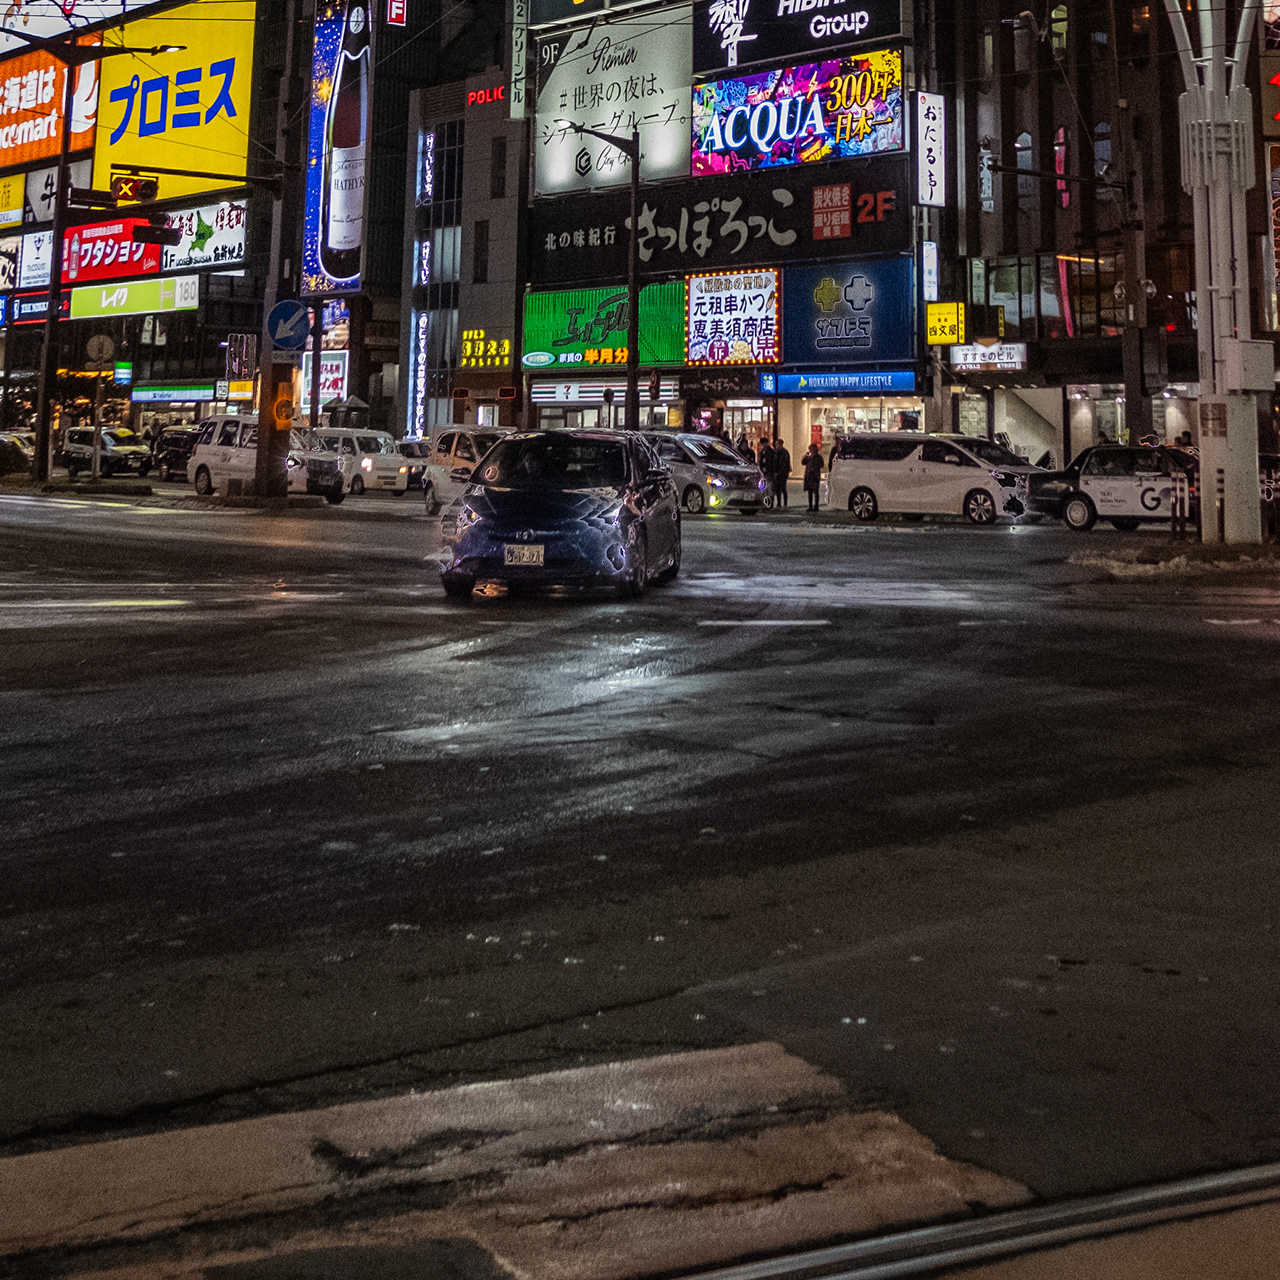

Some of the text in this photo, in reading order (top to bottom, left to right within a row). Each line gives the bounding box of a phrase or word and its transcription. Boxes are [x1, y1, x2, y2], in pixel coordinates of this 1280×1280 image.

[810, 9, 869, 39] Group
[542, 43, 559, 66] 9F
[110, 57, 237, 146] プロミス
[826, 70, 893, 111] 300坪
[700, 93, 826, 153] ACQUA
[836, 109, 893, 144] 日本一
[857, 191, 896, 224] 2F
[625, 188, 797, 263] さっぽろっこ
[545, 225, 616, 251] 北の味紀行
[164, 249, 176, 268] 1F
[101, 287, 128, 309] レイク
[179, 281, 196, 302] 180
[694, 293, 766, 317] 元祖串かつ
[693, 315, 775, 340] 恵美須商店
[929, 324, 957, 336] 四文屋
[584, 347, 629, 365] 半月分
[962, 352, 1014, 361] すすきのビル
[808, 375, 892, 388] HOKKAIDO HAPPY LIFESTYLE
